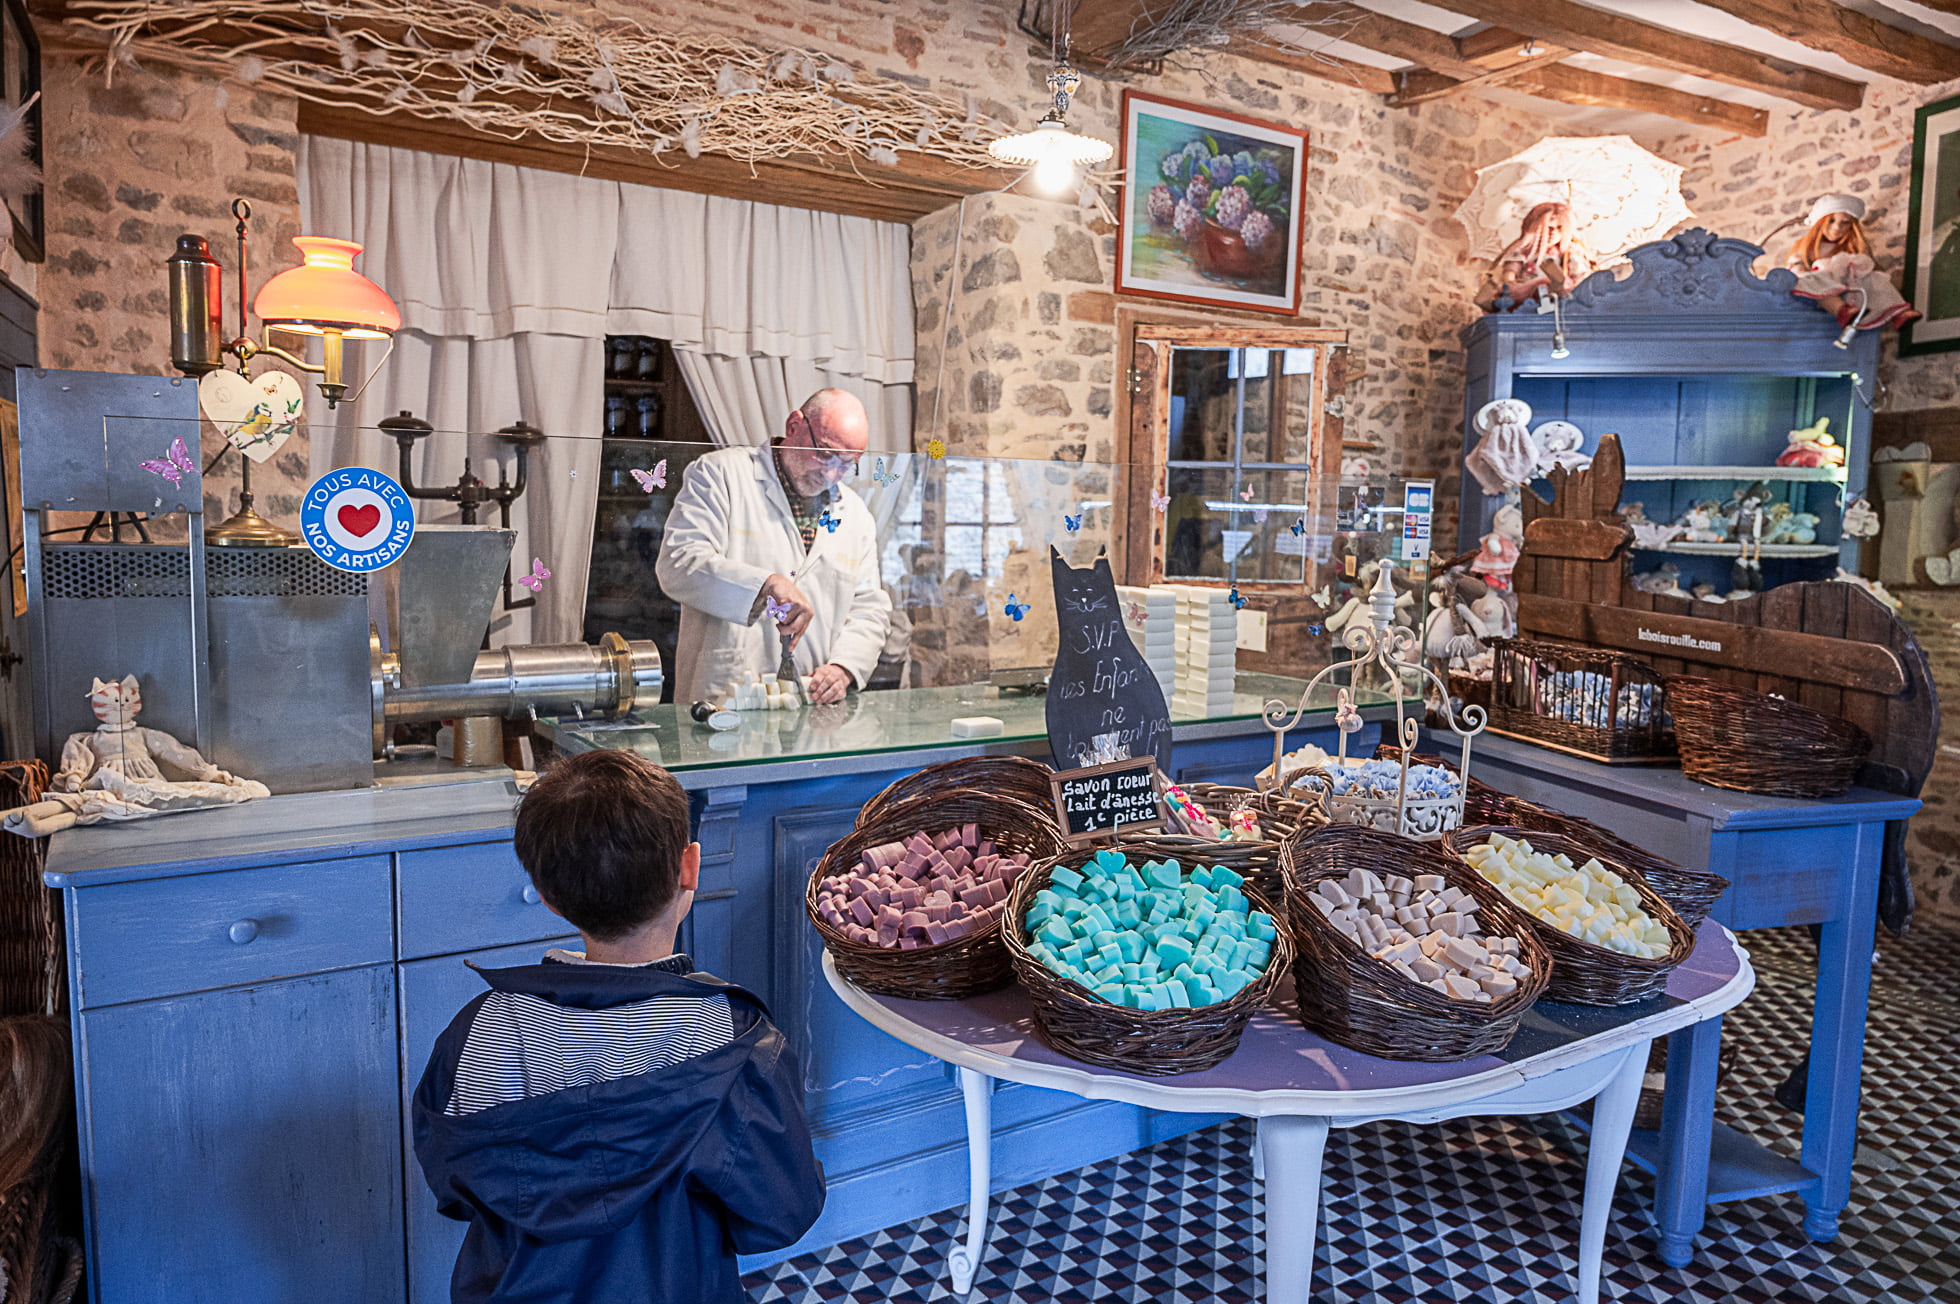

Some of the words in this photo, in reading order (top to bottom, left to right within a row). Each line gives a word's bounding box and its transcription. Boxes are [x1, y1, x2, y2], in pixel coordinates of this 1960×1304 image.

[308, 474, 352, 510] TOUS
[357, 474, 404, 509] AVEC
[306, 522, 337, 558] NOS
[336, 520, 410, 568] ARTISANS
[1637, 627, 1722, 652] leboisrouille.com
[1100, 706, 1127, 727] ne
[1117, 773, 1154, 790] coeur
[1067, 793, 1097, 812] Lait
